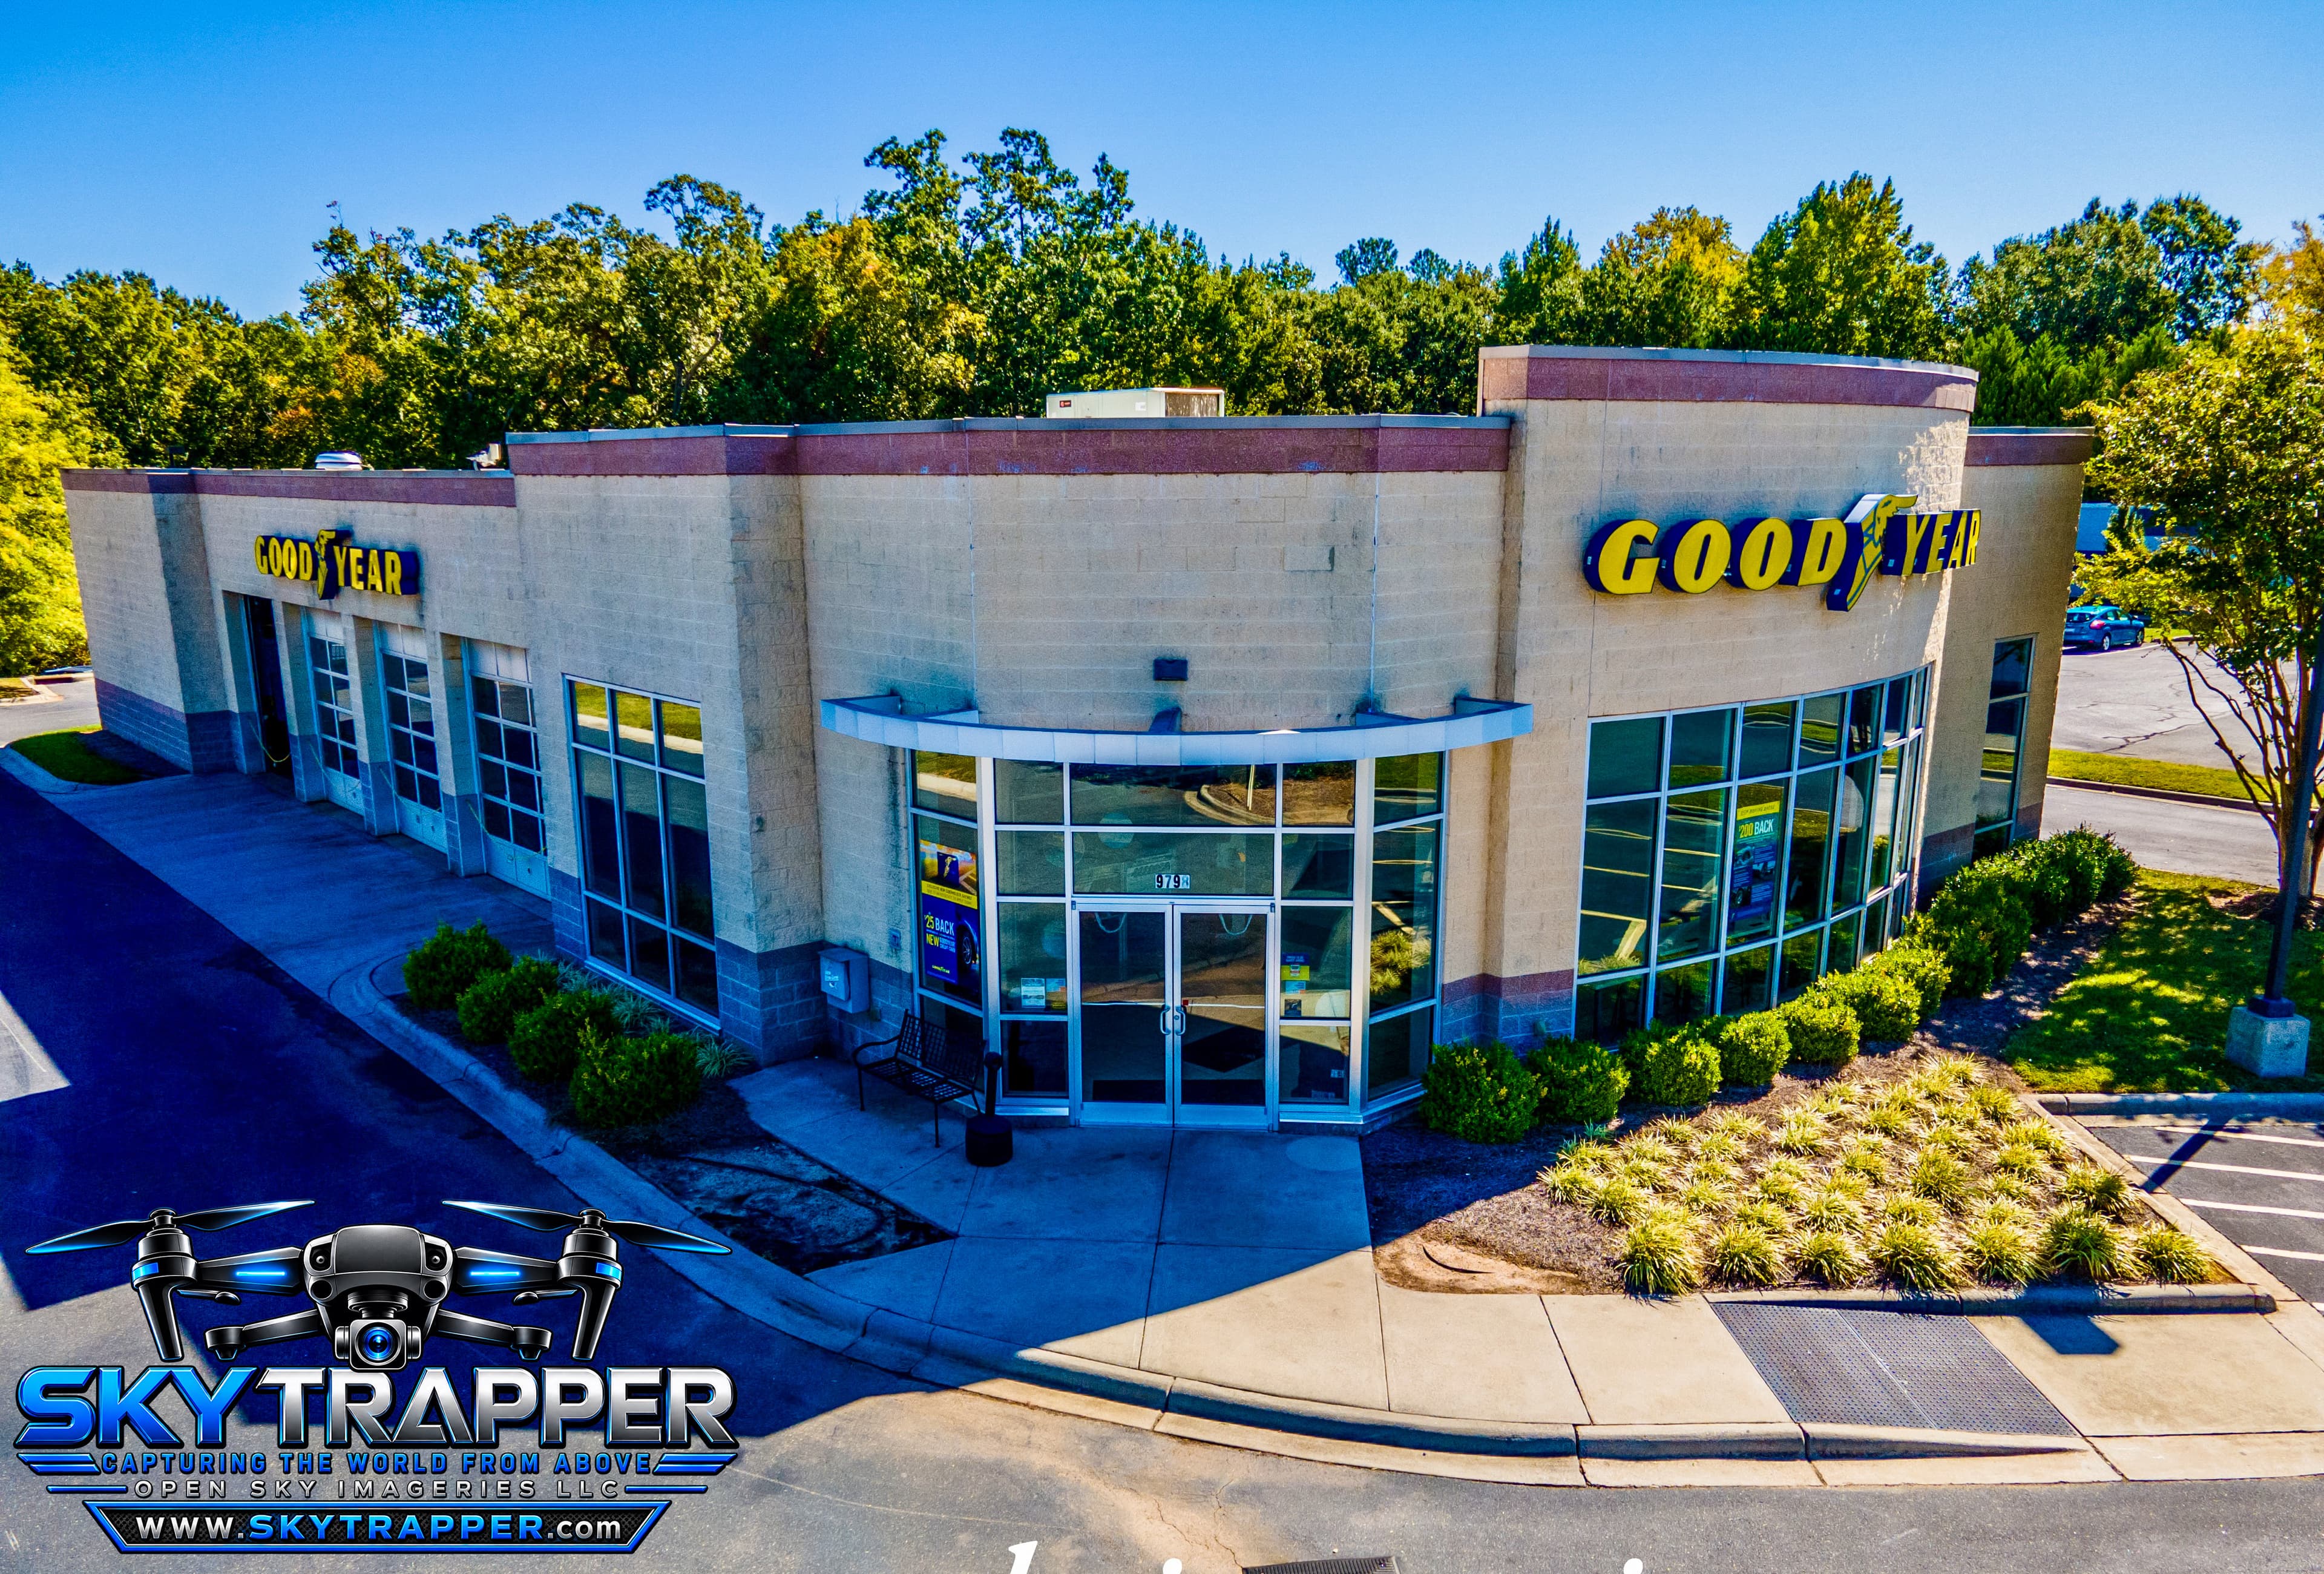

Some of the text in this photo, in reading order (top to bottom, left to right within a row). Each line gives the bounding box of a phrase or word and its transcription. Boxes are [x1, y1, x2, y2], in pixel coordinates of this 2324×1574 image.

[1754, 818, 1774, 835] BACK
[935, 917, 954, 936] BACK
[926, 933, 939, 947] NEW
